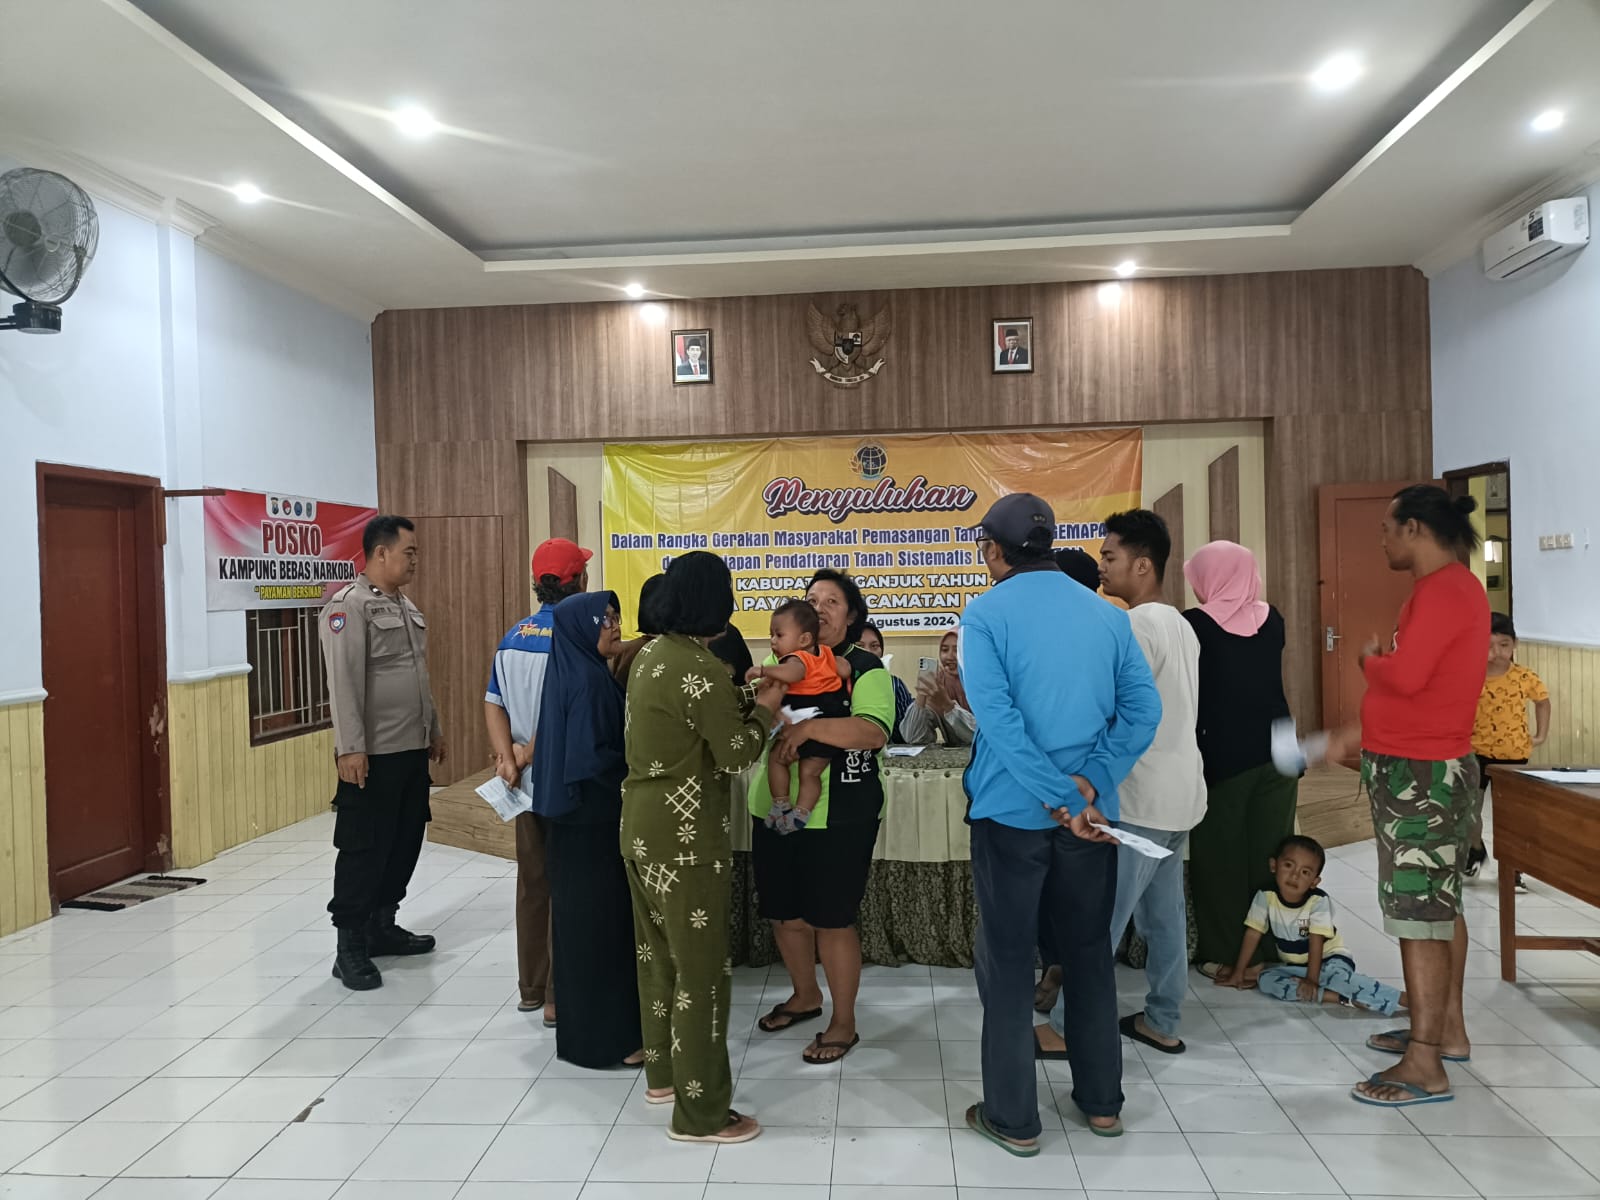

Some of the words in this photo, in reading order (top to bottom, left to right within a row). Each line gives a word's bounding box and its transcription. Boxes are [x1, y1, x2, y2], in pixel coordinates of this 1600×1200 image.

[763, 476, 976, 523] Penyuluhan
[262, 522, 321, 556] POSKO
[612, 534, 652, 549] Dalam
[658, 533, 707, 549] Rangka
[713, 532, 769, 547] Gerakan
[775, 530, 857, 548] Masyarakat
[862, 529, 949, 544] Pemasangan
[219, 558, 276, 579] KAMPUNG
[280, 561, 310, 580] BEBAS
[314, 562, 355, 580] NARKOBA
[766, 553, 849, 569] Pendaftaran
[854, 552, 892, 566] Tanah
[898, 550, 971, 566] Sistematis
[850, 574, 924, 588] GANJUK
[927, 573, 987, 587] TAHUN
[864, 593, 960, 608] CAMATAN
[868, 617, 920, 628] Agustus
[923, 616, 955, 626] 2024
